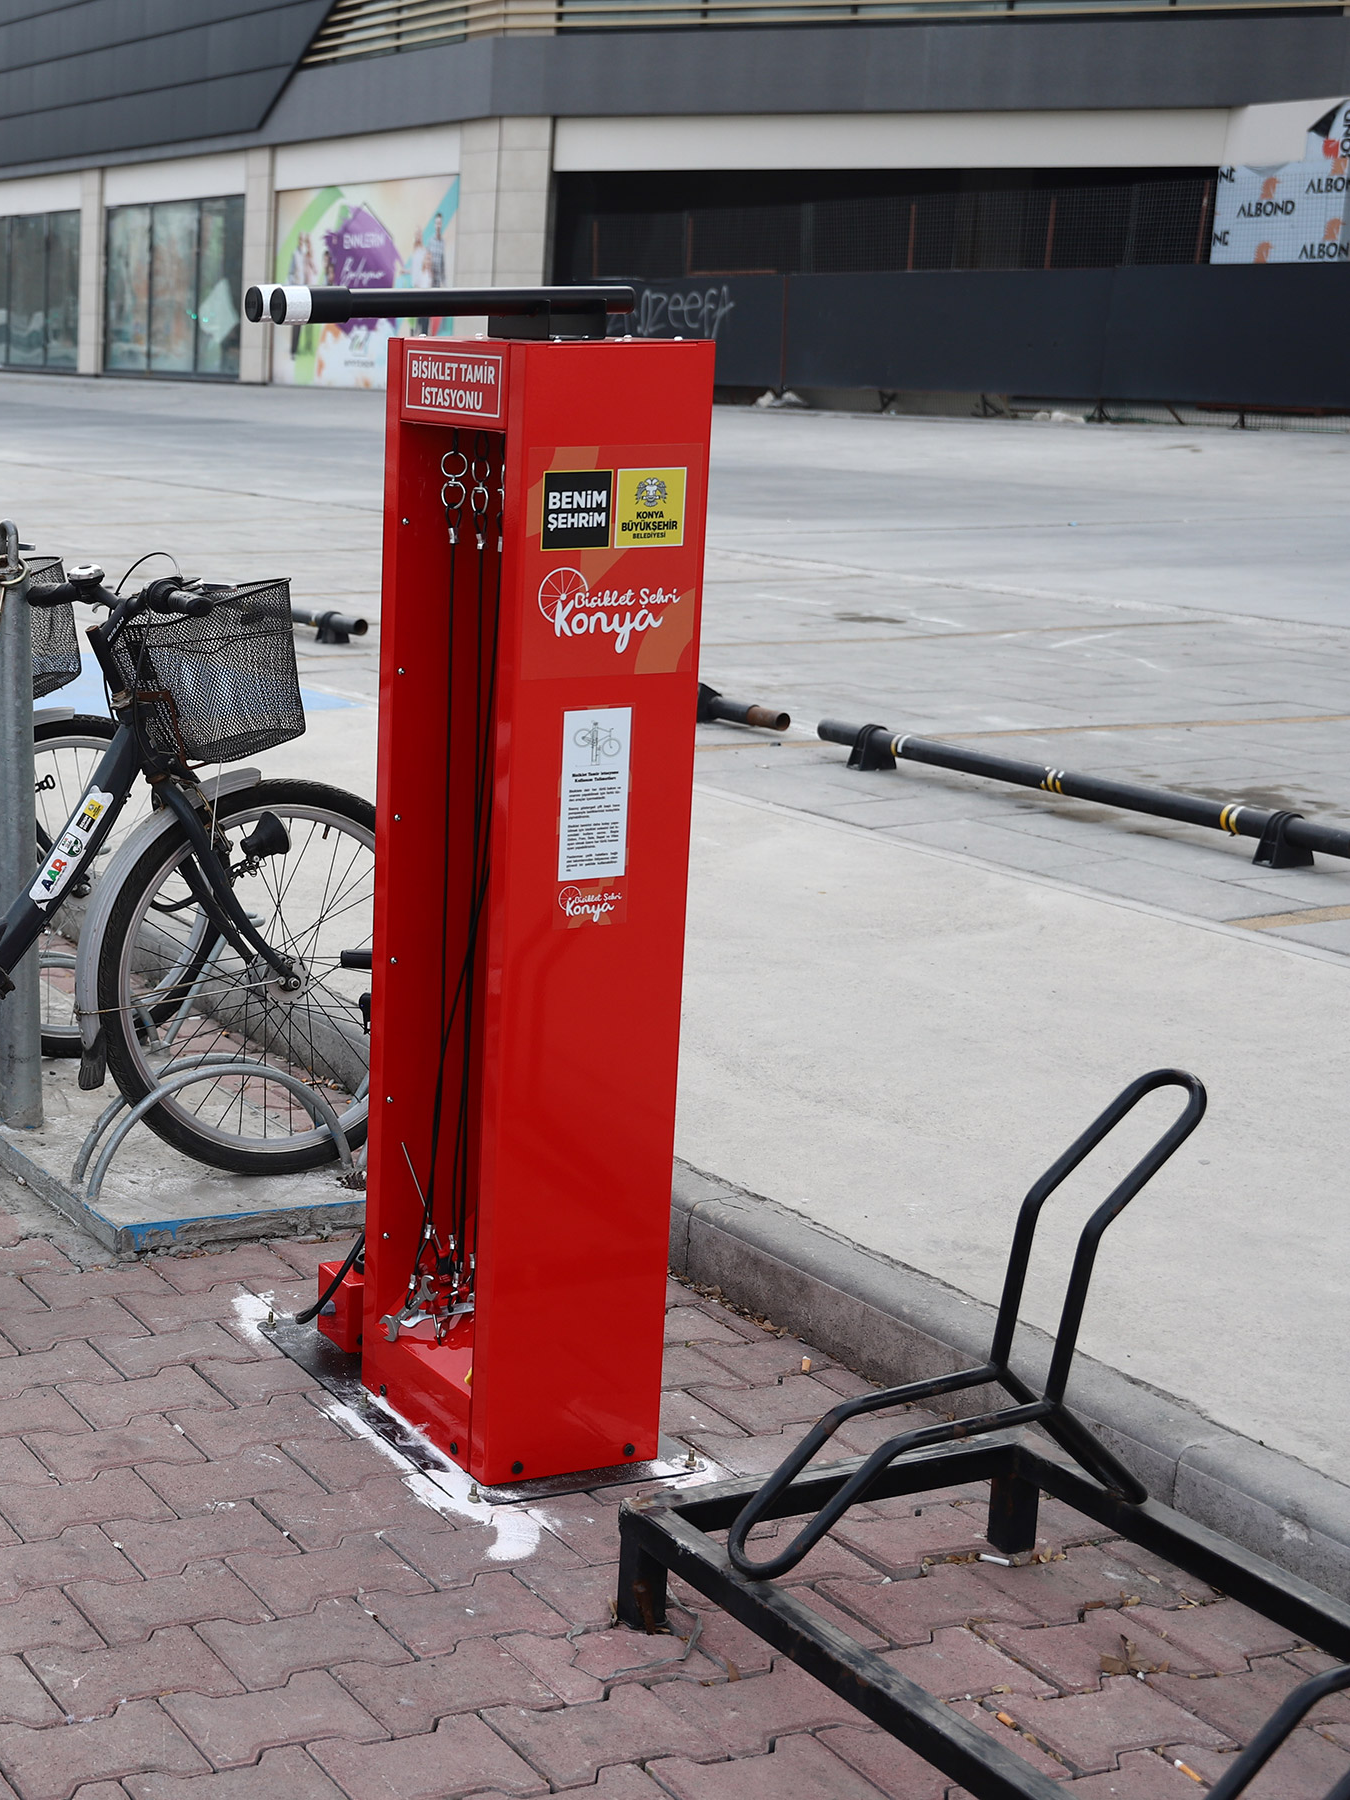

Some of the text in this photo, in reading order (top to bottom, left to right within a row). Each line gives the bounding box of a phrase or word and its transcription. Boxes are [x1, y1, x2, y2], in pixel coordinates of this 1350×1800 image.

[1237, 200, 1296, 218] ALBOND
[411, 356, 496, 385] BİSİKLET TAMİR
[420, 382, 483, 411] İSTASYONU
[621, 518, 678, 533] BÜYÜKŞEHİR
[636, 511, 664, 520] KONYA
[575, 588, 680, 609] Bisiklet Şehri
[554, 600, 663, 654] Konya
[41, 858, 68, 893] AAR
[566, 898, 616, 923] Konya
